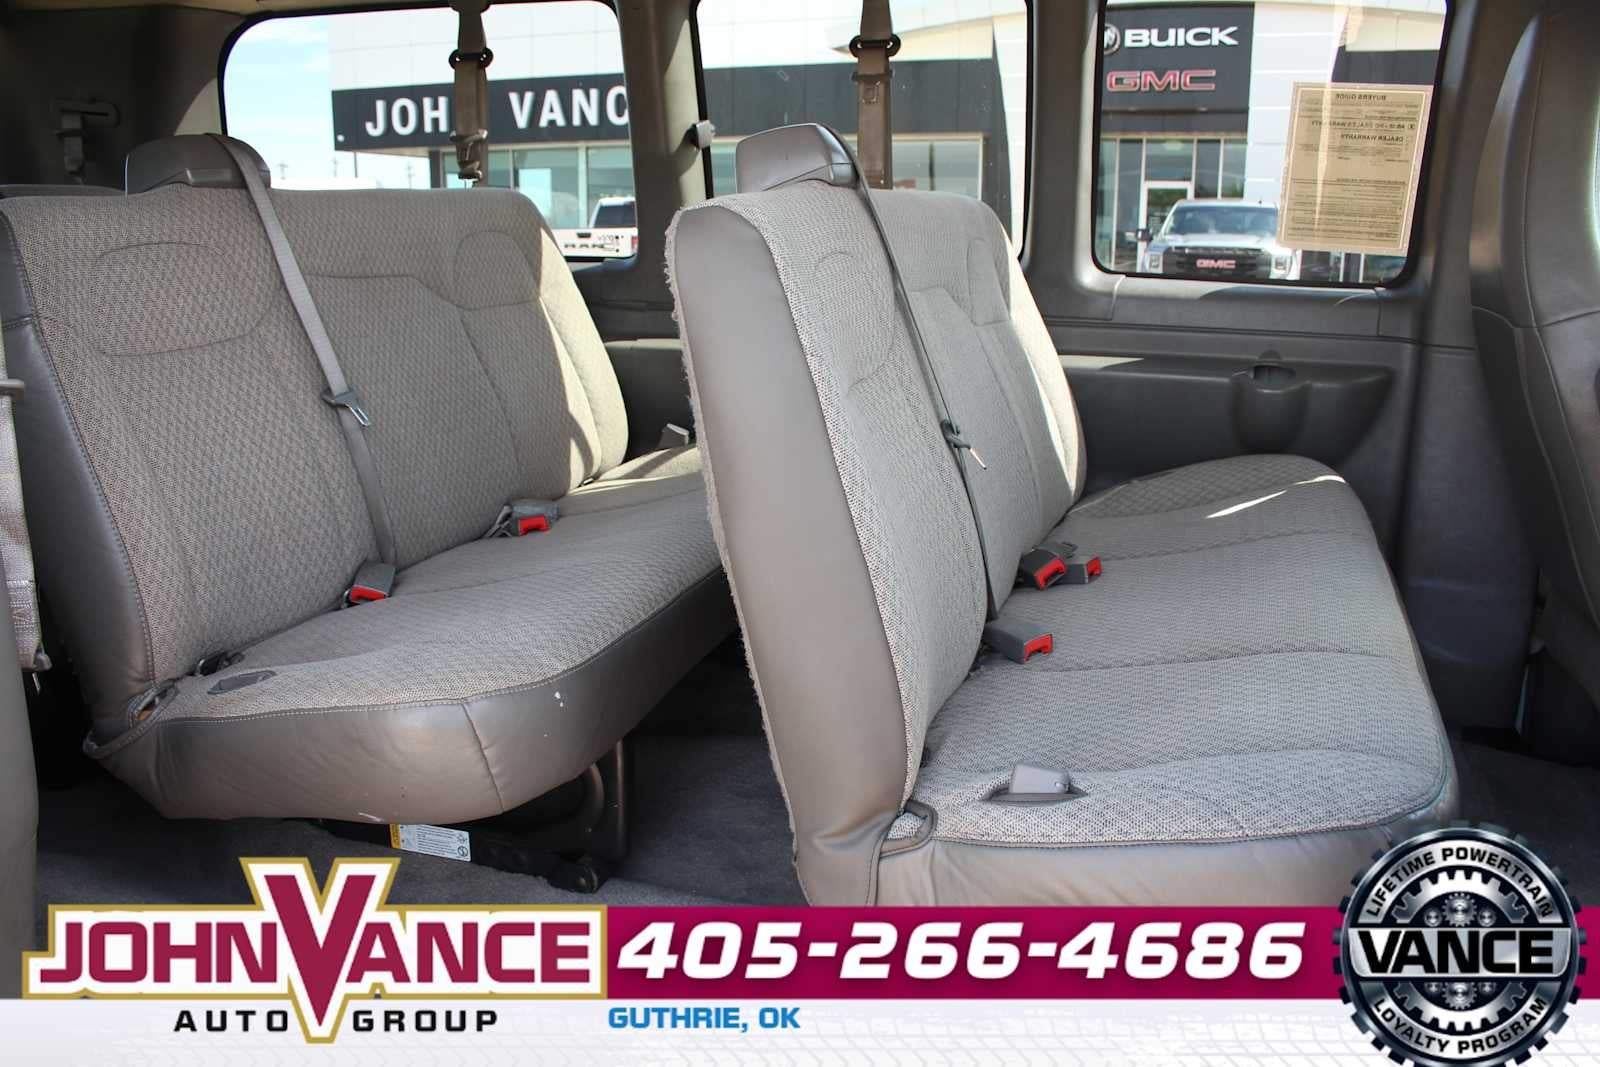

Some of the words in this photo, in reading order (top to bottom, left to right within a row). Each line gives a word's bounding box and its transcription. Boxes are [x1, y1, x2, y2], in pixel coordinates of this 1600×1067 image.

[1124, 27, 1239, 47] BUICK
[1107, 70, 1216, 91] GMC
[365, 95, 449, 136] JOH
[508, 86, 629, 129] VANC
[1196, 259, 1237, 268] GMC
